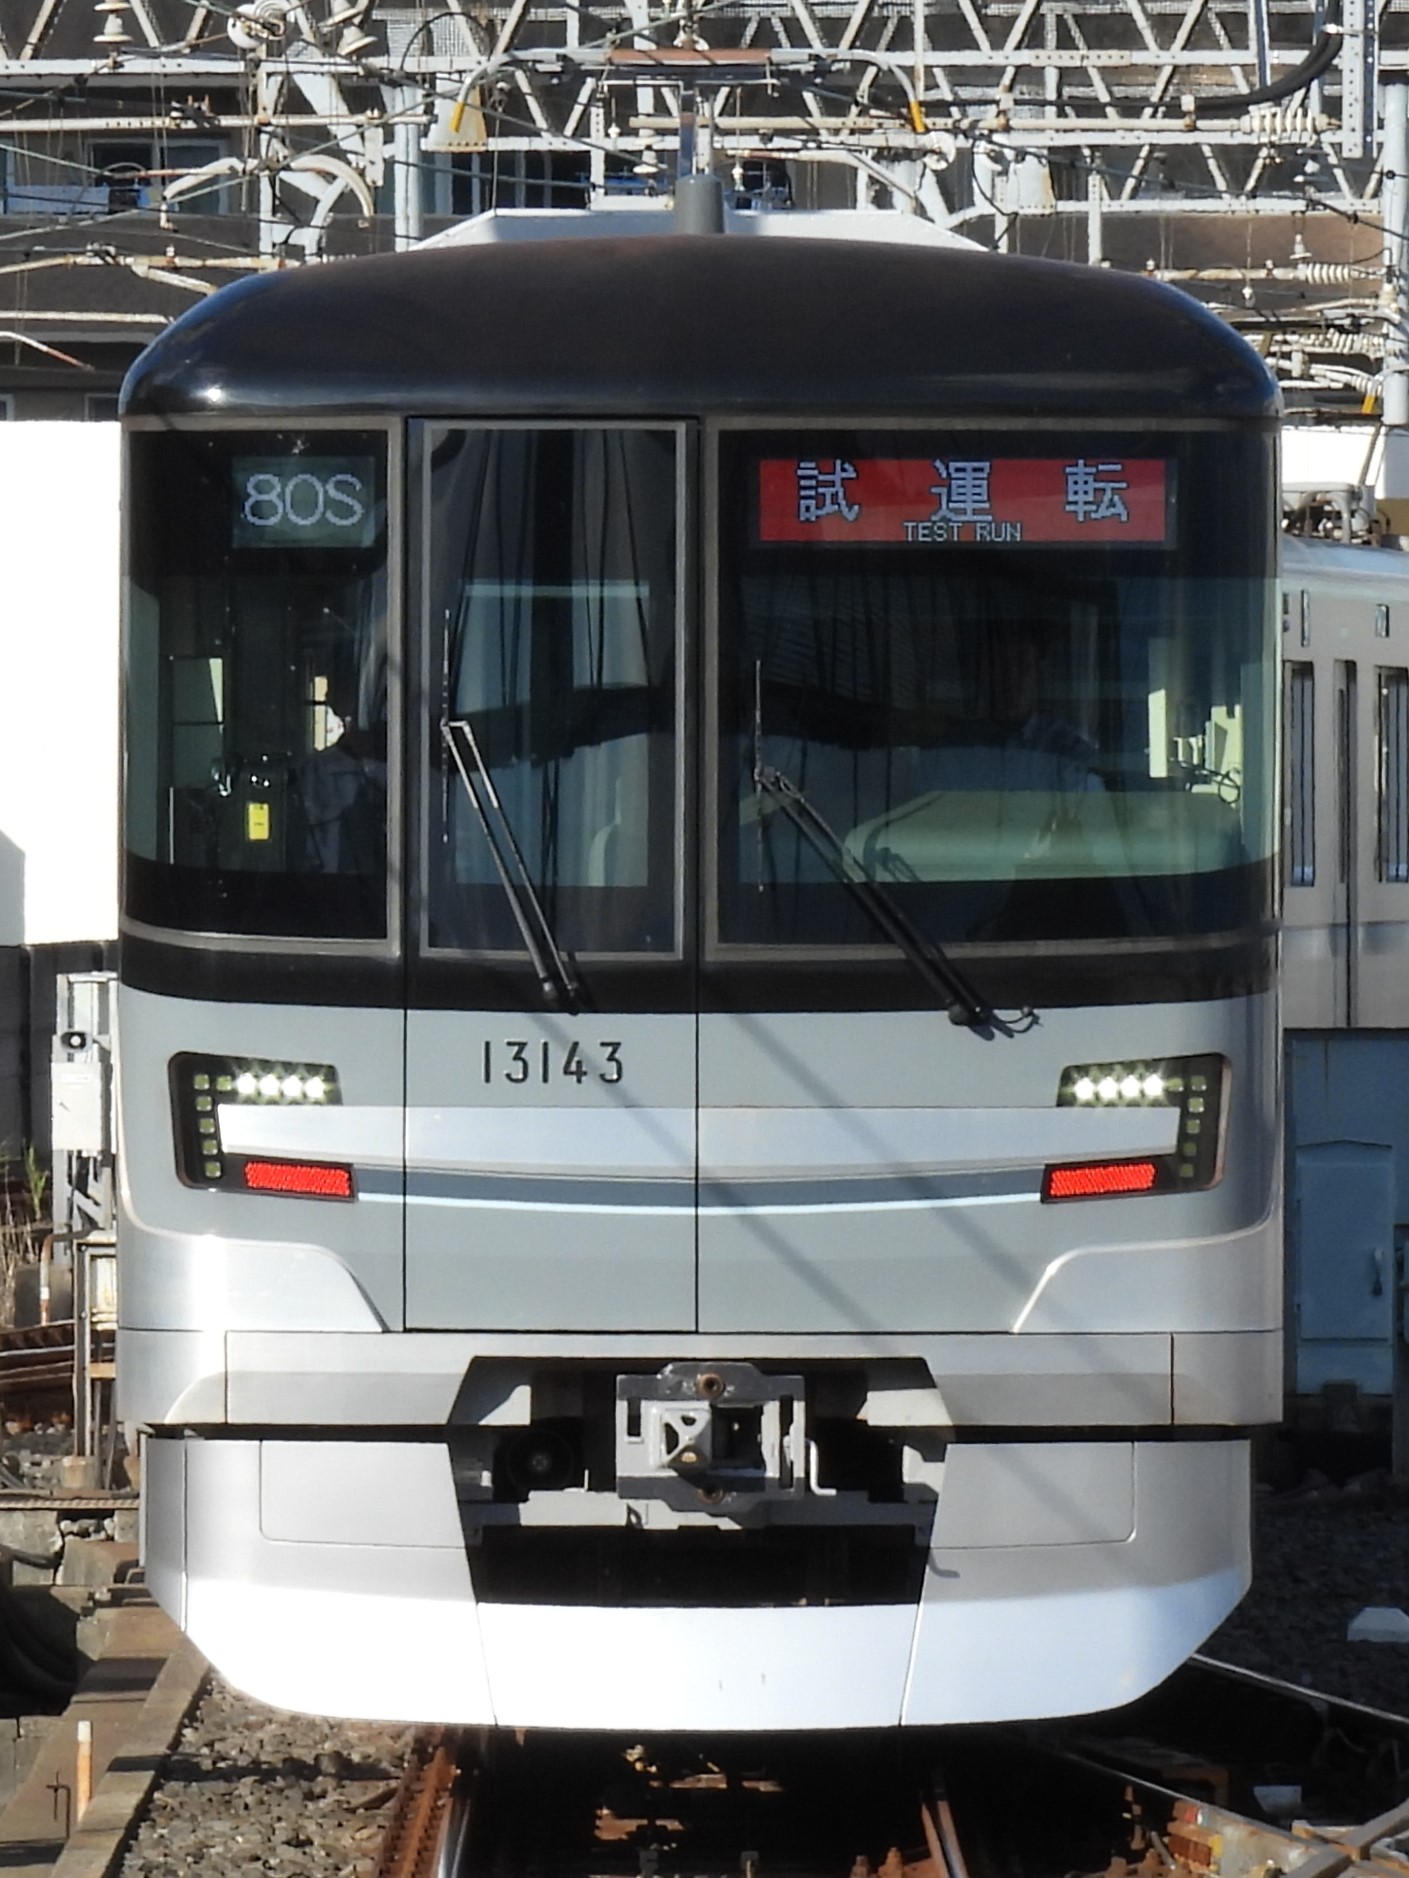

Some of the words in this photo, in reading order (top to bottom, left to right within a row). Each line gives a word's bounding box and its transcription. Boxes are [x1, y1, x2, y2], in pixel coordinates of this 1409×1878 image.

[244, 473, 364, 526] 80S
[797, 459, 1129, 523] 試運転
[904, 522, 963, 542] TEST
[975, 522, 1022, 542] RUN
[483, 1040, 623, 1084] 13143
